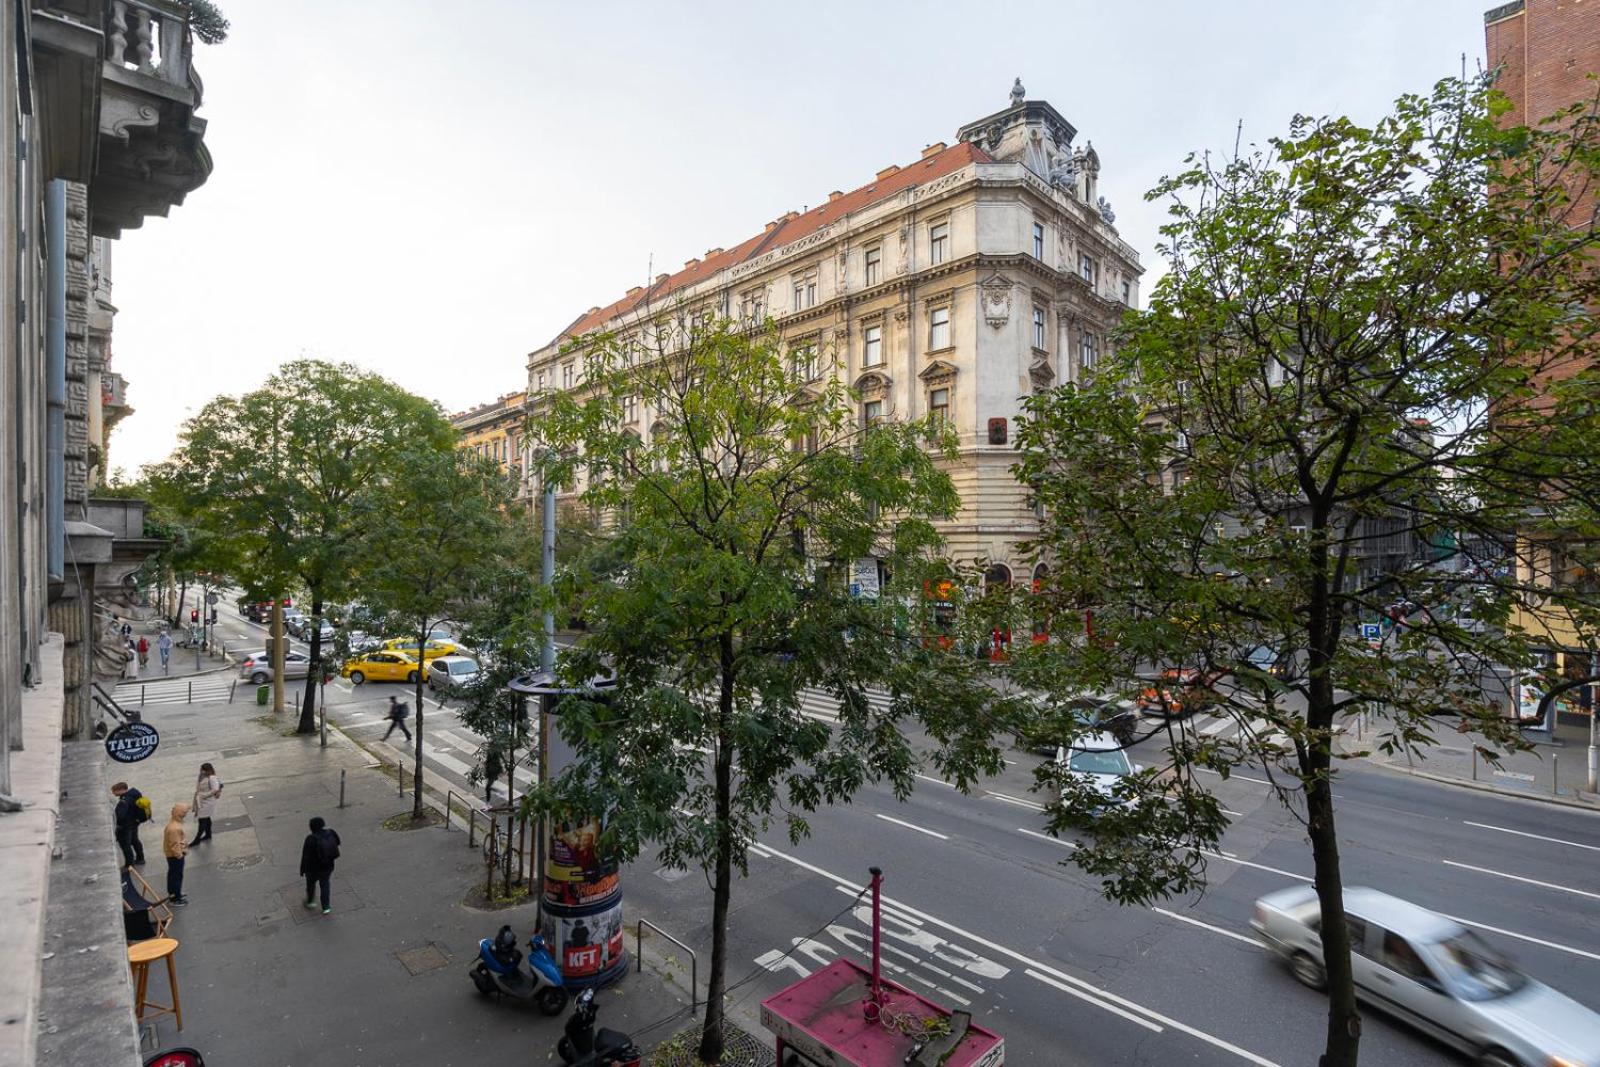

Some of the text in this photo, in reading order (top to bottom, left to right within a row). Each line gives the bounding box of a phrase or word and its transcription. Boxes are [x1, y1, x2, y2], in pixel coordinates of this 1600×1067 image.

[1367, 626, 1377, 637] P
[108, 734, 158, 752] TATTOO
[568, 948, 597, 967] KFT
